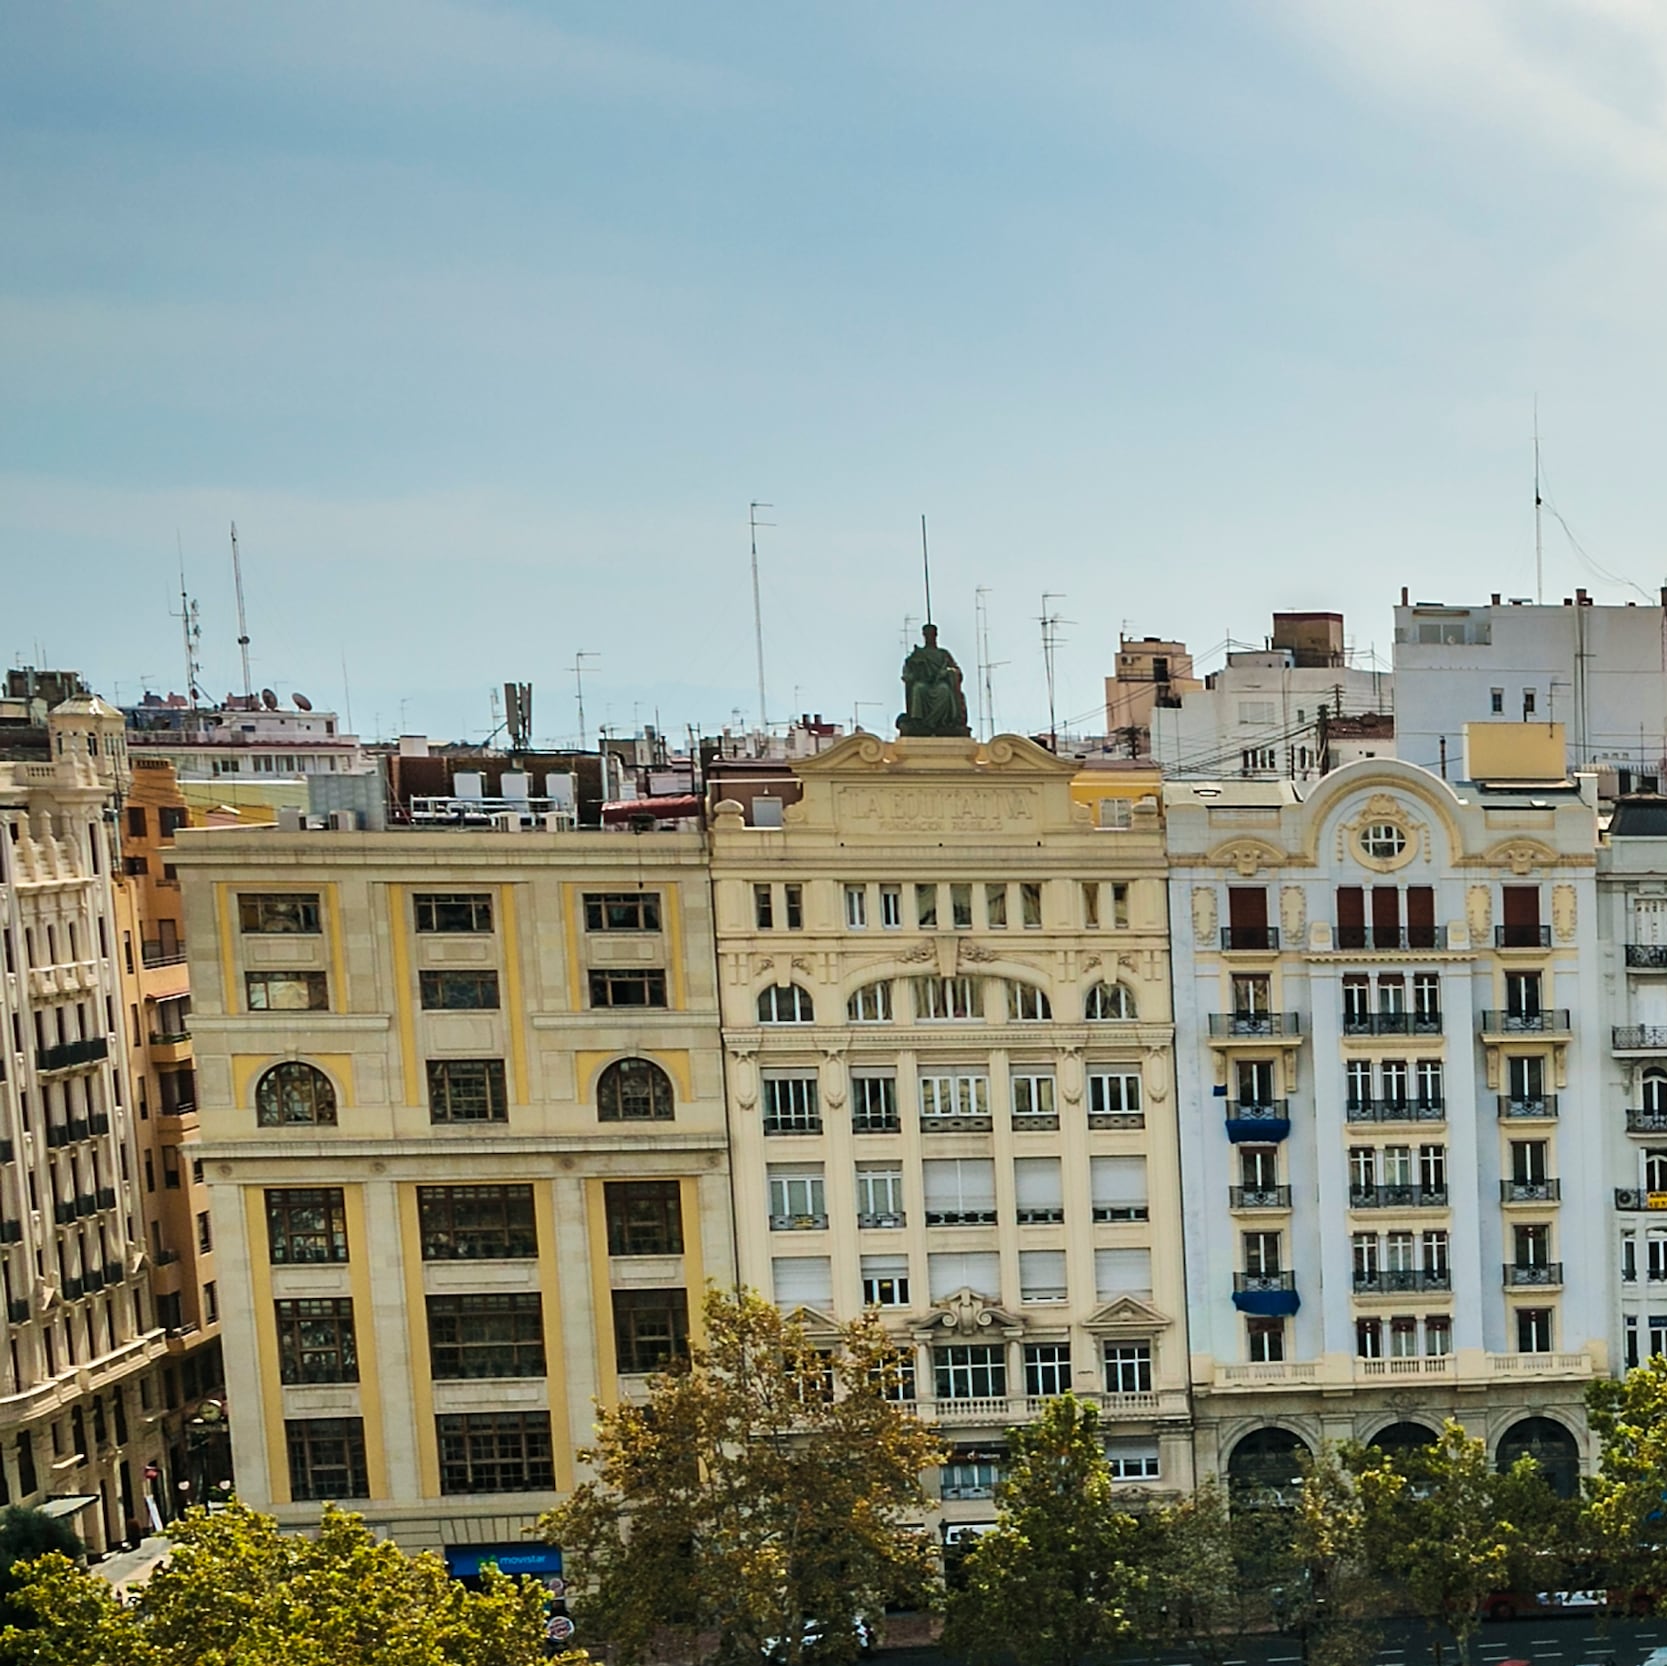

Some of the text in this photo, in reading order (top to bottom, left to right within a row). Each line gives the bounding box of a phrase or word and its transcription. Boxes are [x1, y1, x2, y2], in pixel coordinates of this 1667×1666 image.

[849, 789, 1033, 820] LA EQUITATIVA
[499, 1555, 547, 1566] movistar
